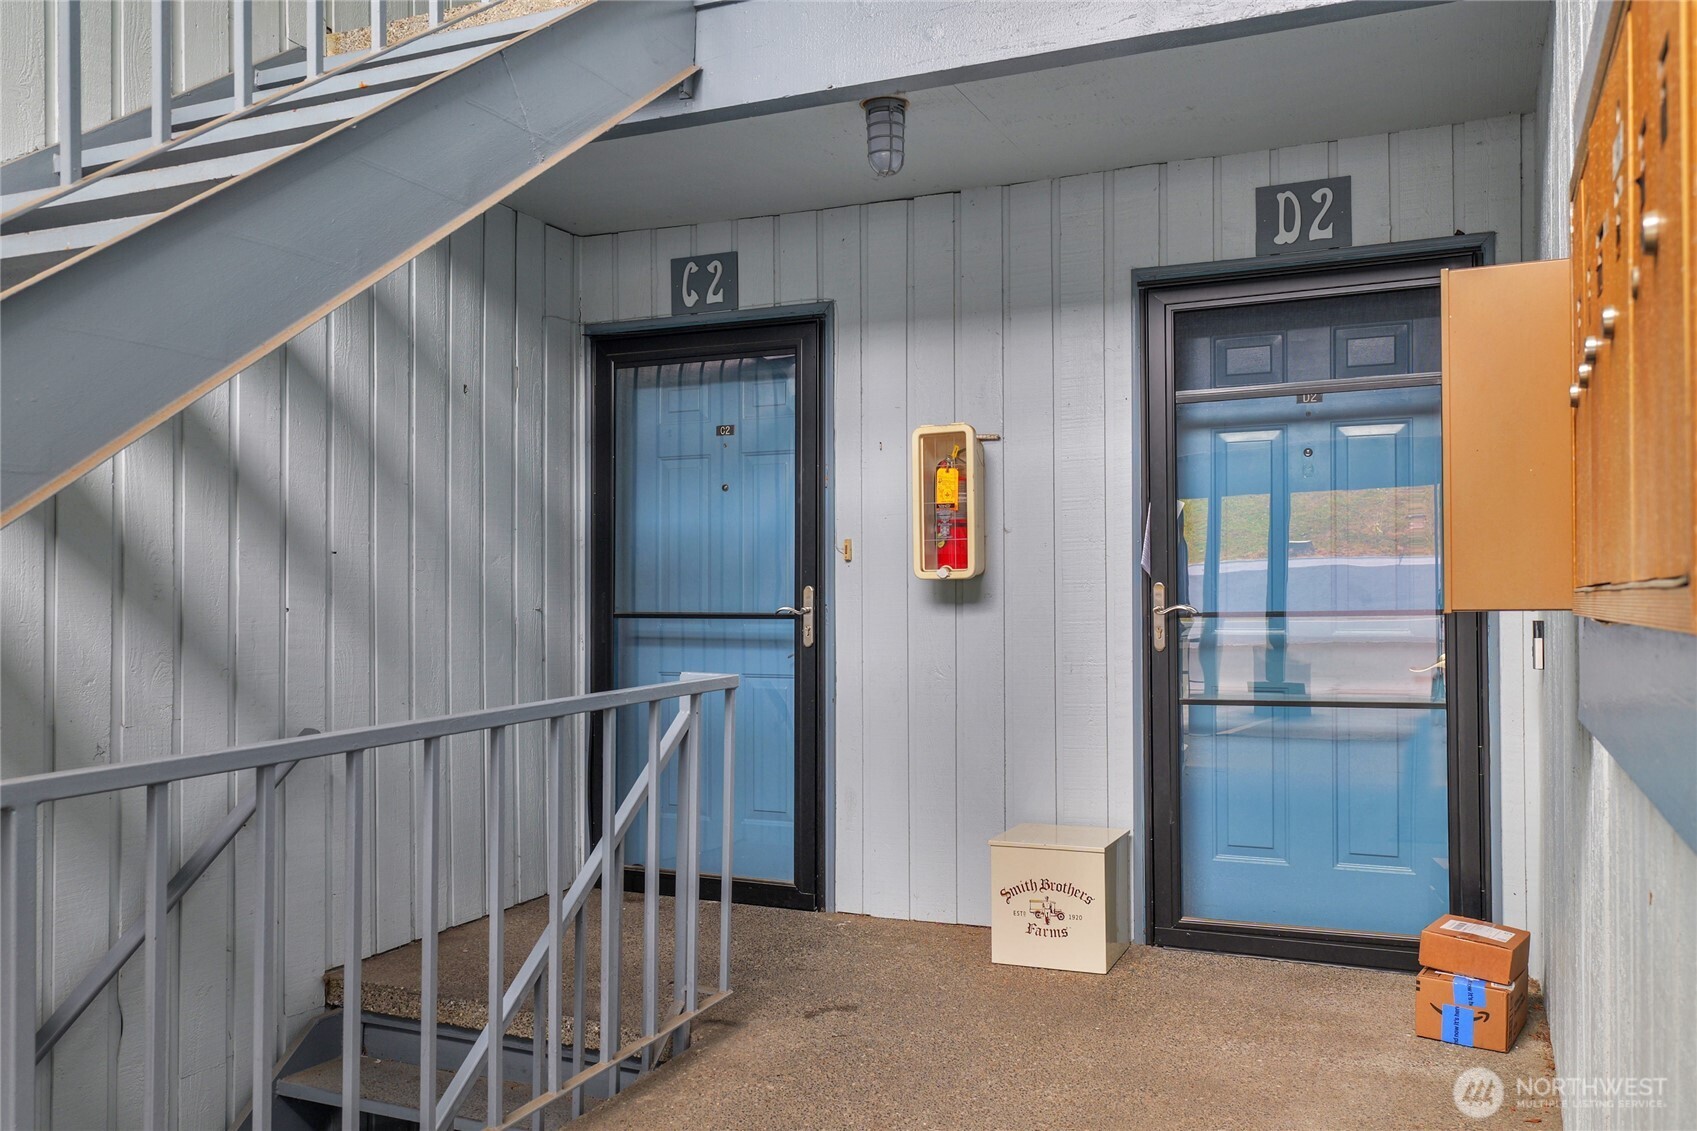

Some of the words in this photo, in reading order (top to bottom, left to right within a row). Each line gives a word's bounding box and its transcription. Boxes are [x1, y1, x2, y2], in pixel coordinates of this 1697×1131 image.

[1273, 187, 1334, 245] D2
[682, 260, 724, 308] C2
[720, 425, 731, 435] C2
[1000, 879, 1038, 905] Smith
[1039, 878, 1096, 905] Brothers
[1025, 922, 1069, 938] Farms
